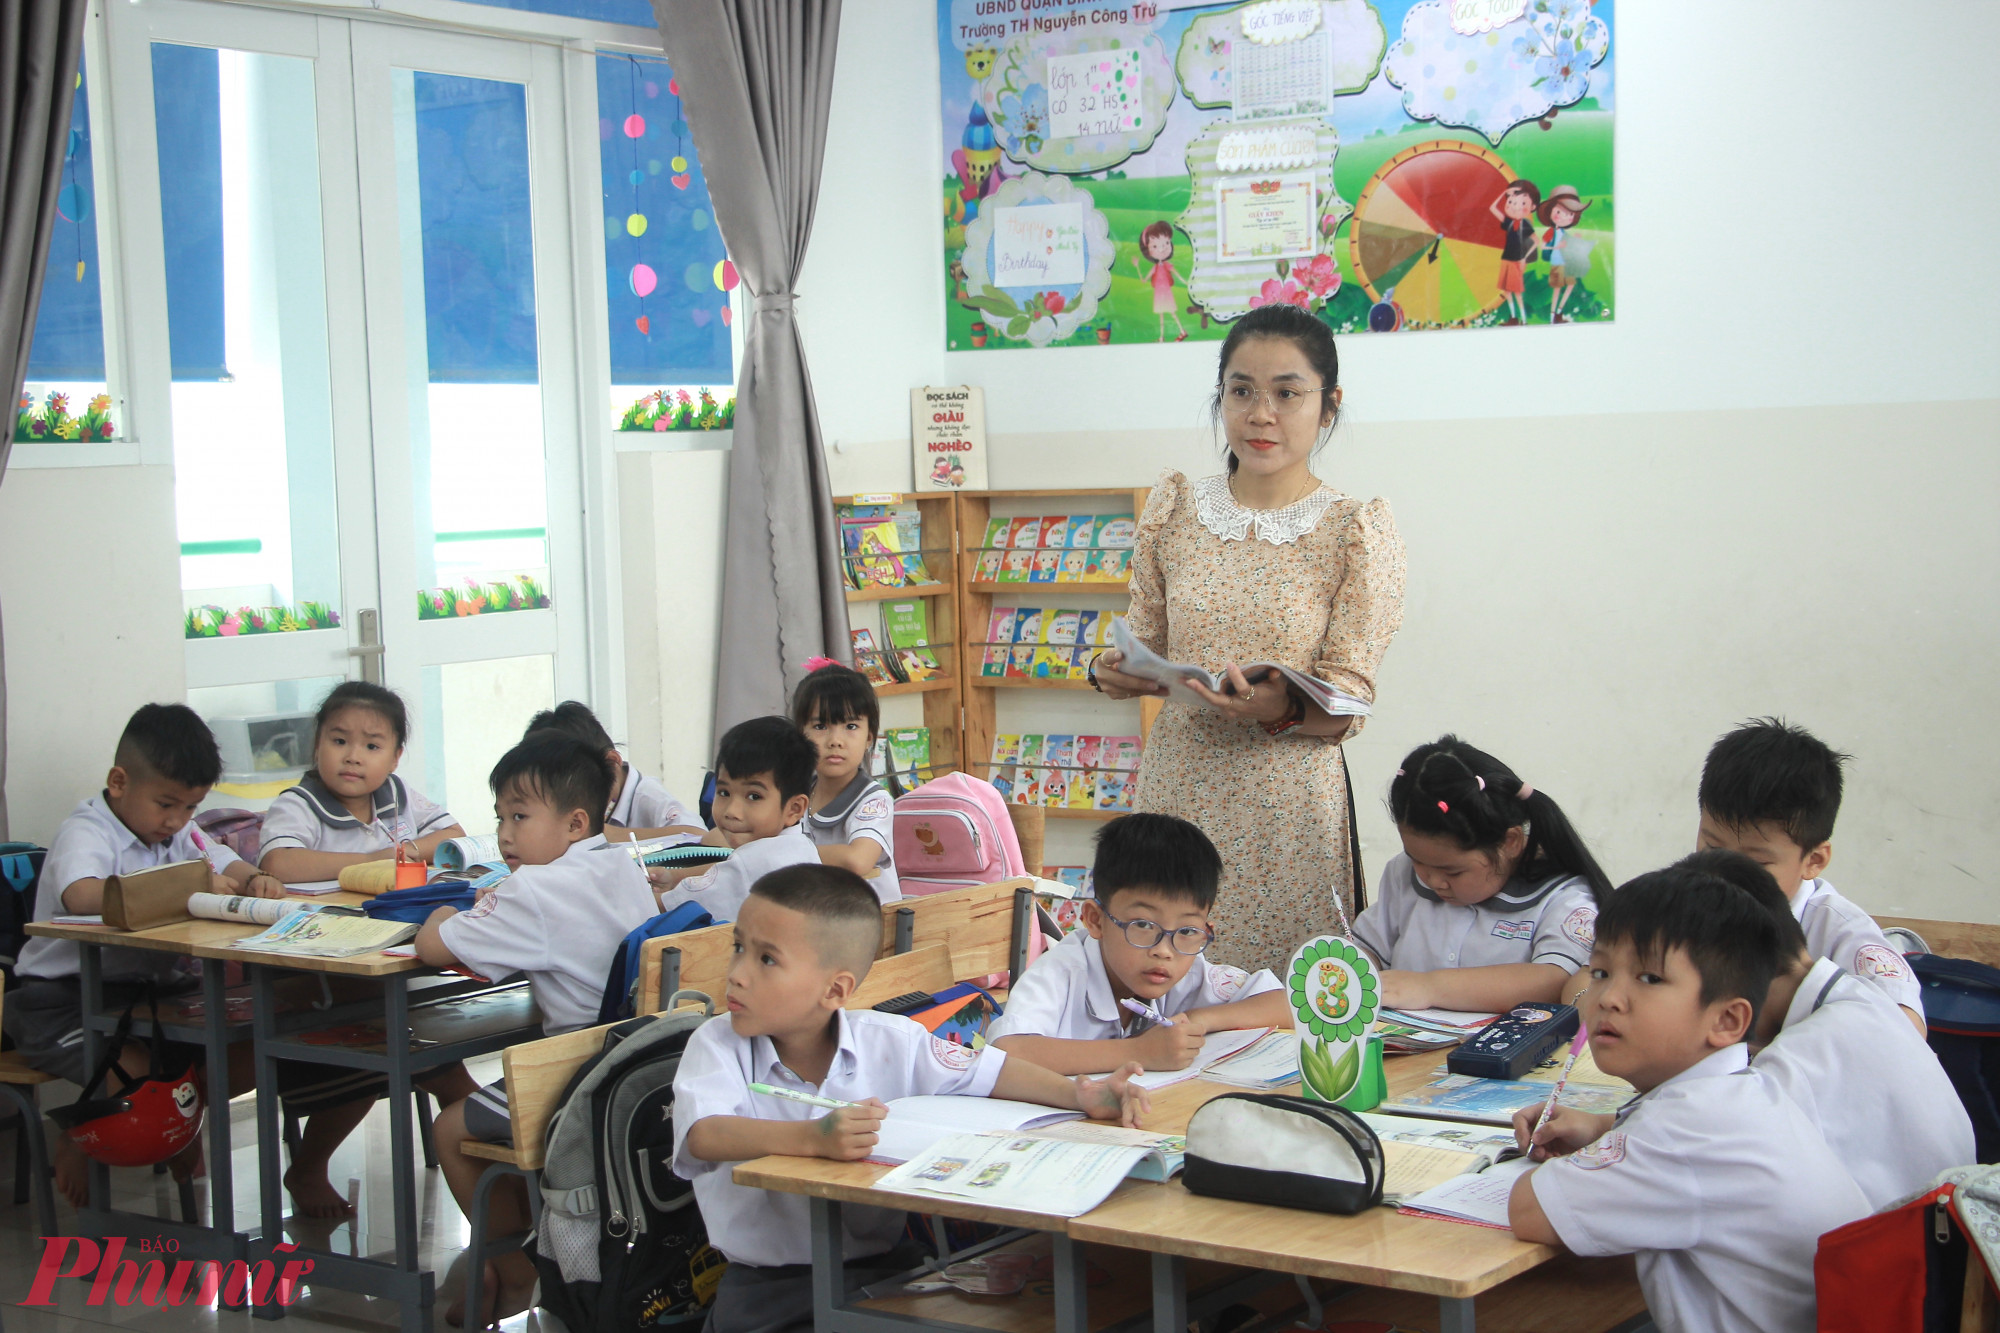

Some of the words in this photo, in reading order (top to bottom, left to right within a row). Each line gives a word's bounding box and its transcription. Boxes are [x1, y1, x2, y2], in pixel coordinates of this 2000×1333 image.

[975, 0, 1016, 16] UBND
[960, 25, 1005, 38] Trường
[1010, 19, 1029, 33] TH
[1033, 10, 1086, 33] Nguyễn
[1091, 9, 1128, 24] Công
[1080, 96, 1096, 112] 32
[1103, 94, 1118, 109] HS
[926, 393, 944, 402] ĐỌC
[946, 391, 969, 400] SÁCH
[933, 410, 964, 423] GIÀU
[928, 439, 972, 452] NGHÈO
[1316, 962, 1350, 1019] 3
